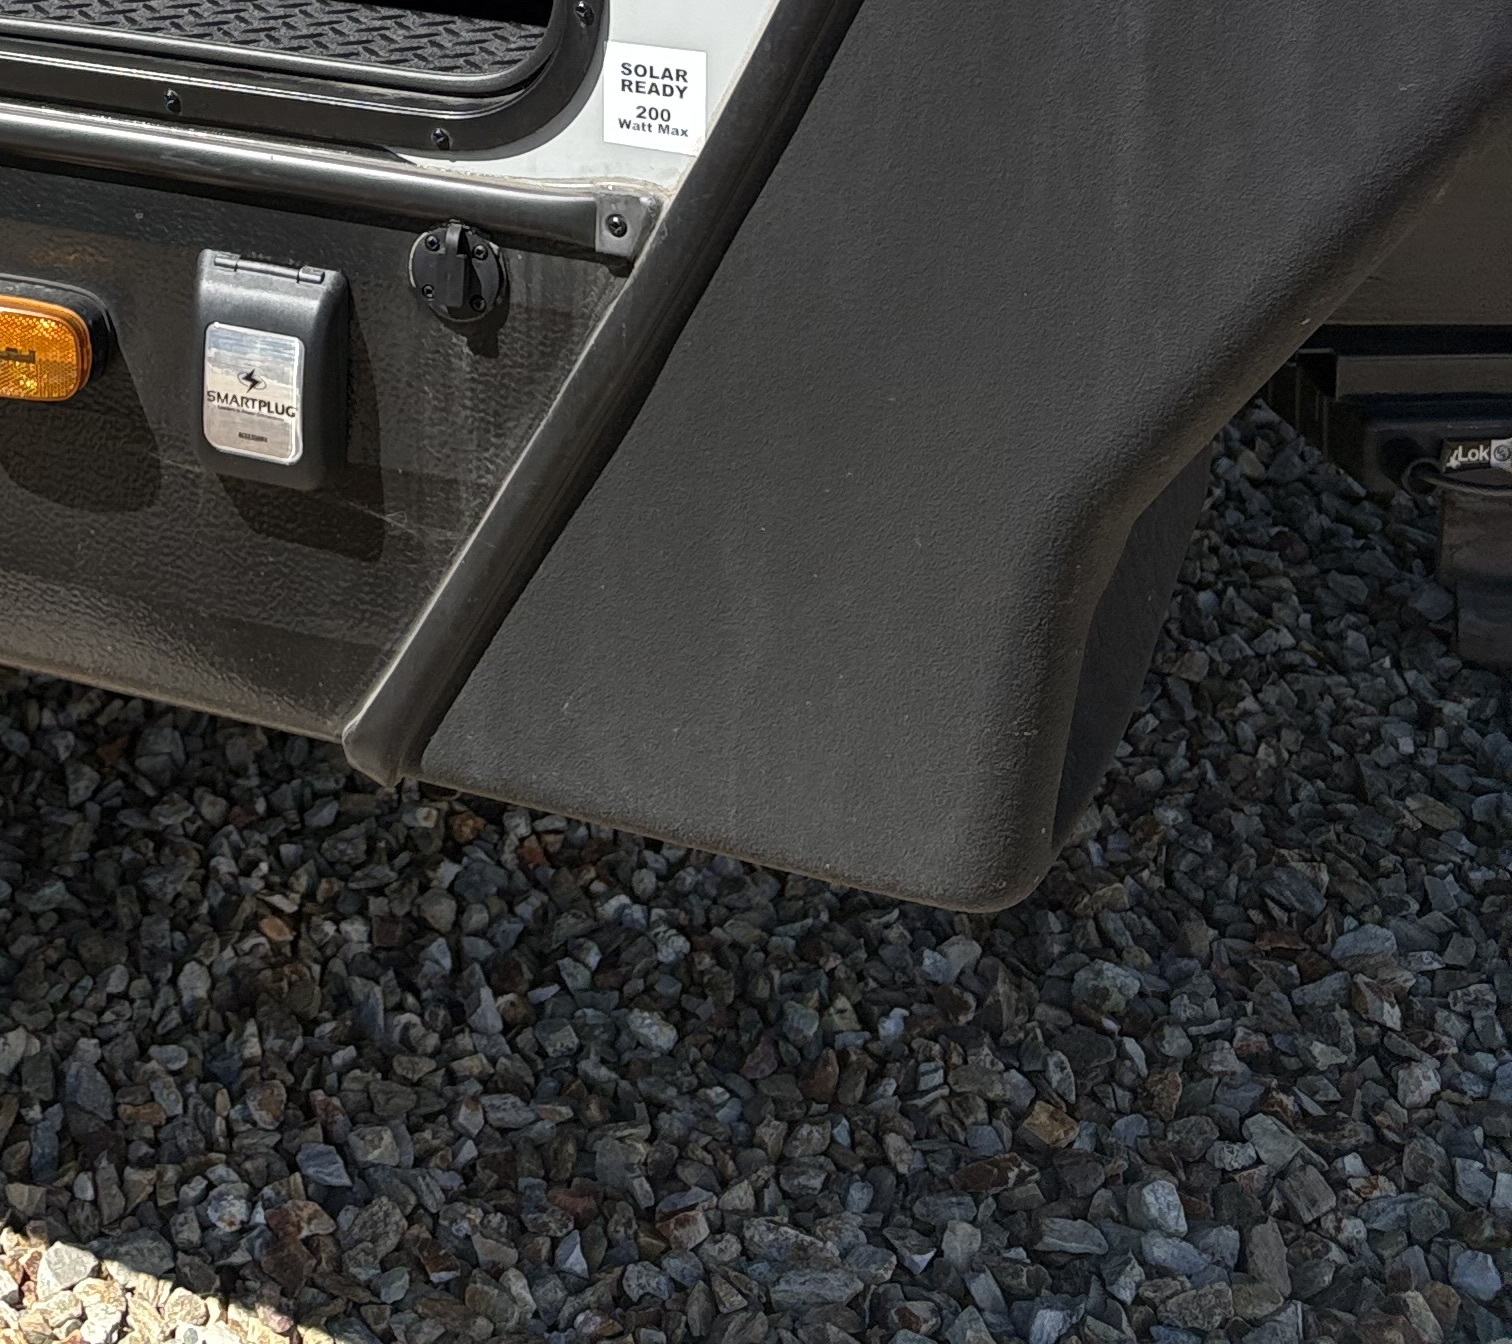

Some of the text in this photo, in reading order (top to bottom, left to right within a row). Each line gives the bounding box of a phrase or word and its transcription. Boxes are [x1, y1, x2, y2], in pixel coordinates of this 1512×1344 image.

[620, 62, 688, 83] SOLAR
[620, 78, 688, 99] READY
[635, 105, 671, 122] 200
[618, 117, 689, 138] Watt Max
[206, 390, 296, 417] SMARTPLUG
